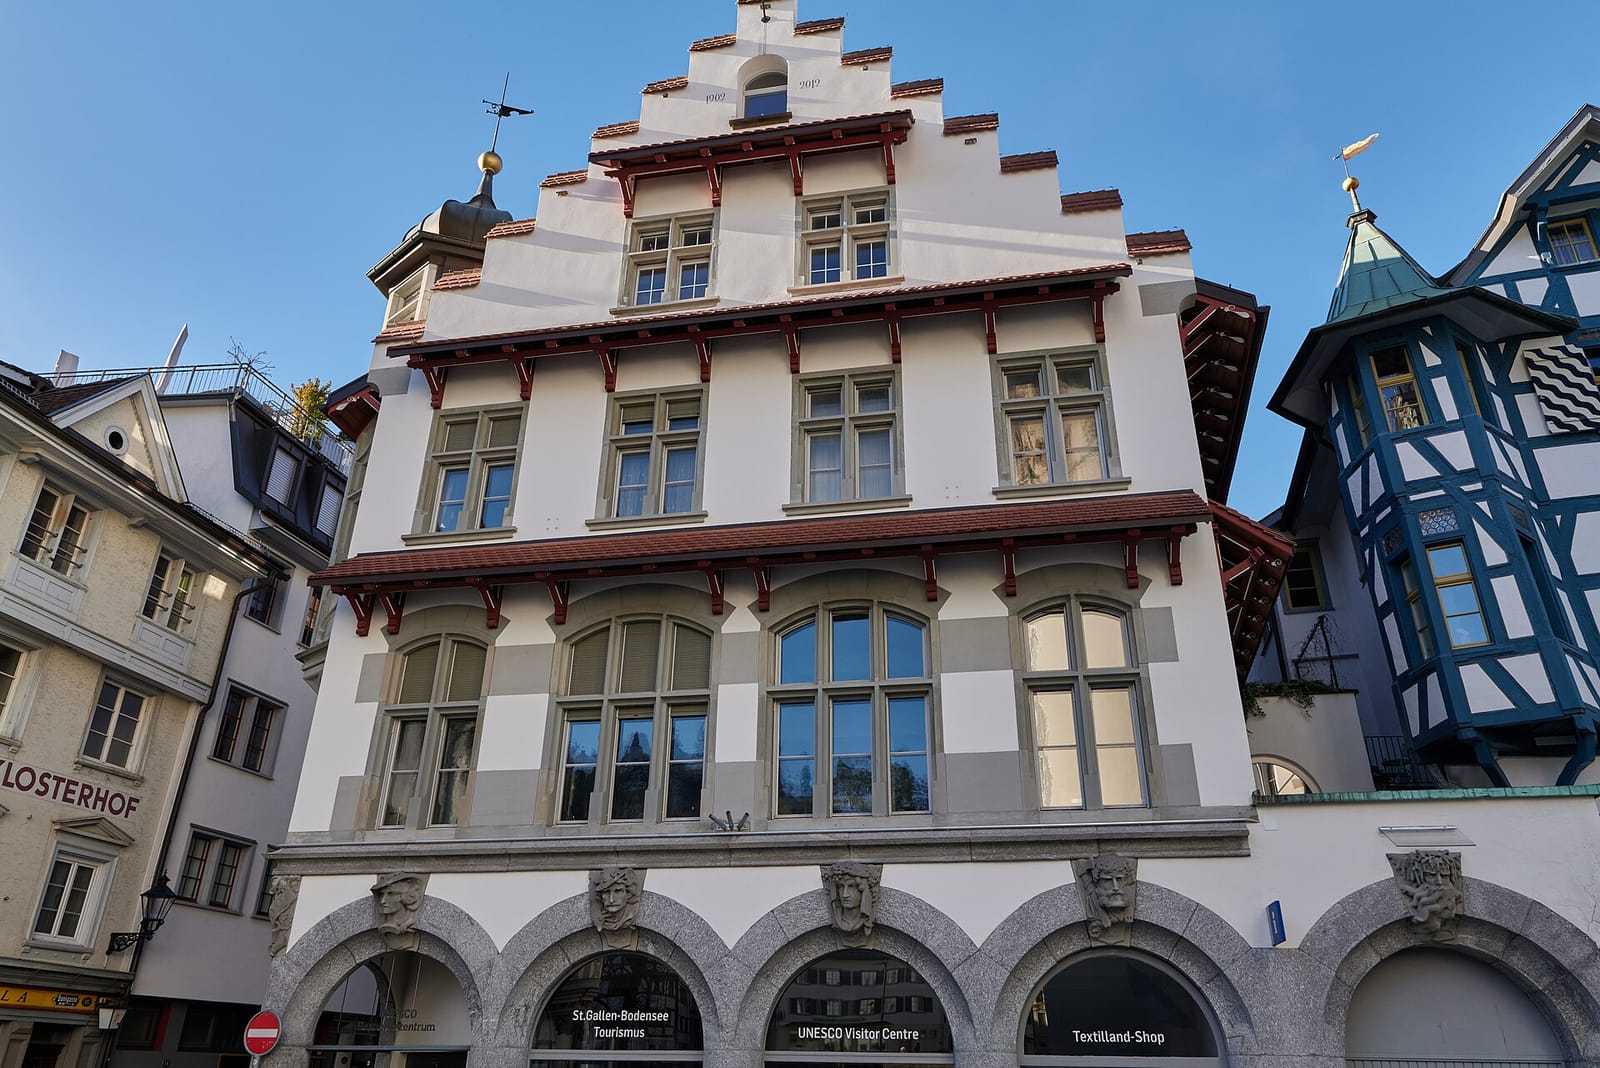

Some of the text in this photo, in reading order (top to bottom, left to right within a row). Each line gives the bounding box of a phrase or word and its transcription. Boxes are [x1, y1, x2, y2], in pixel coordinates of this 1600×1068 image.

[799, 79, 821, 90] 2012
[705, 92, 726, 104] 1902
[0, 759, 140, 818] LOSTERHOF
[593, 1026, 645, 1038] Tourismus
[797, 1026, 919, 1039] UNESCO Visitor Centre
[1072, 1030, 1165, 1046] Textilland-Shop
